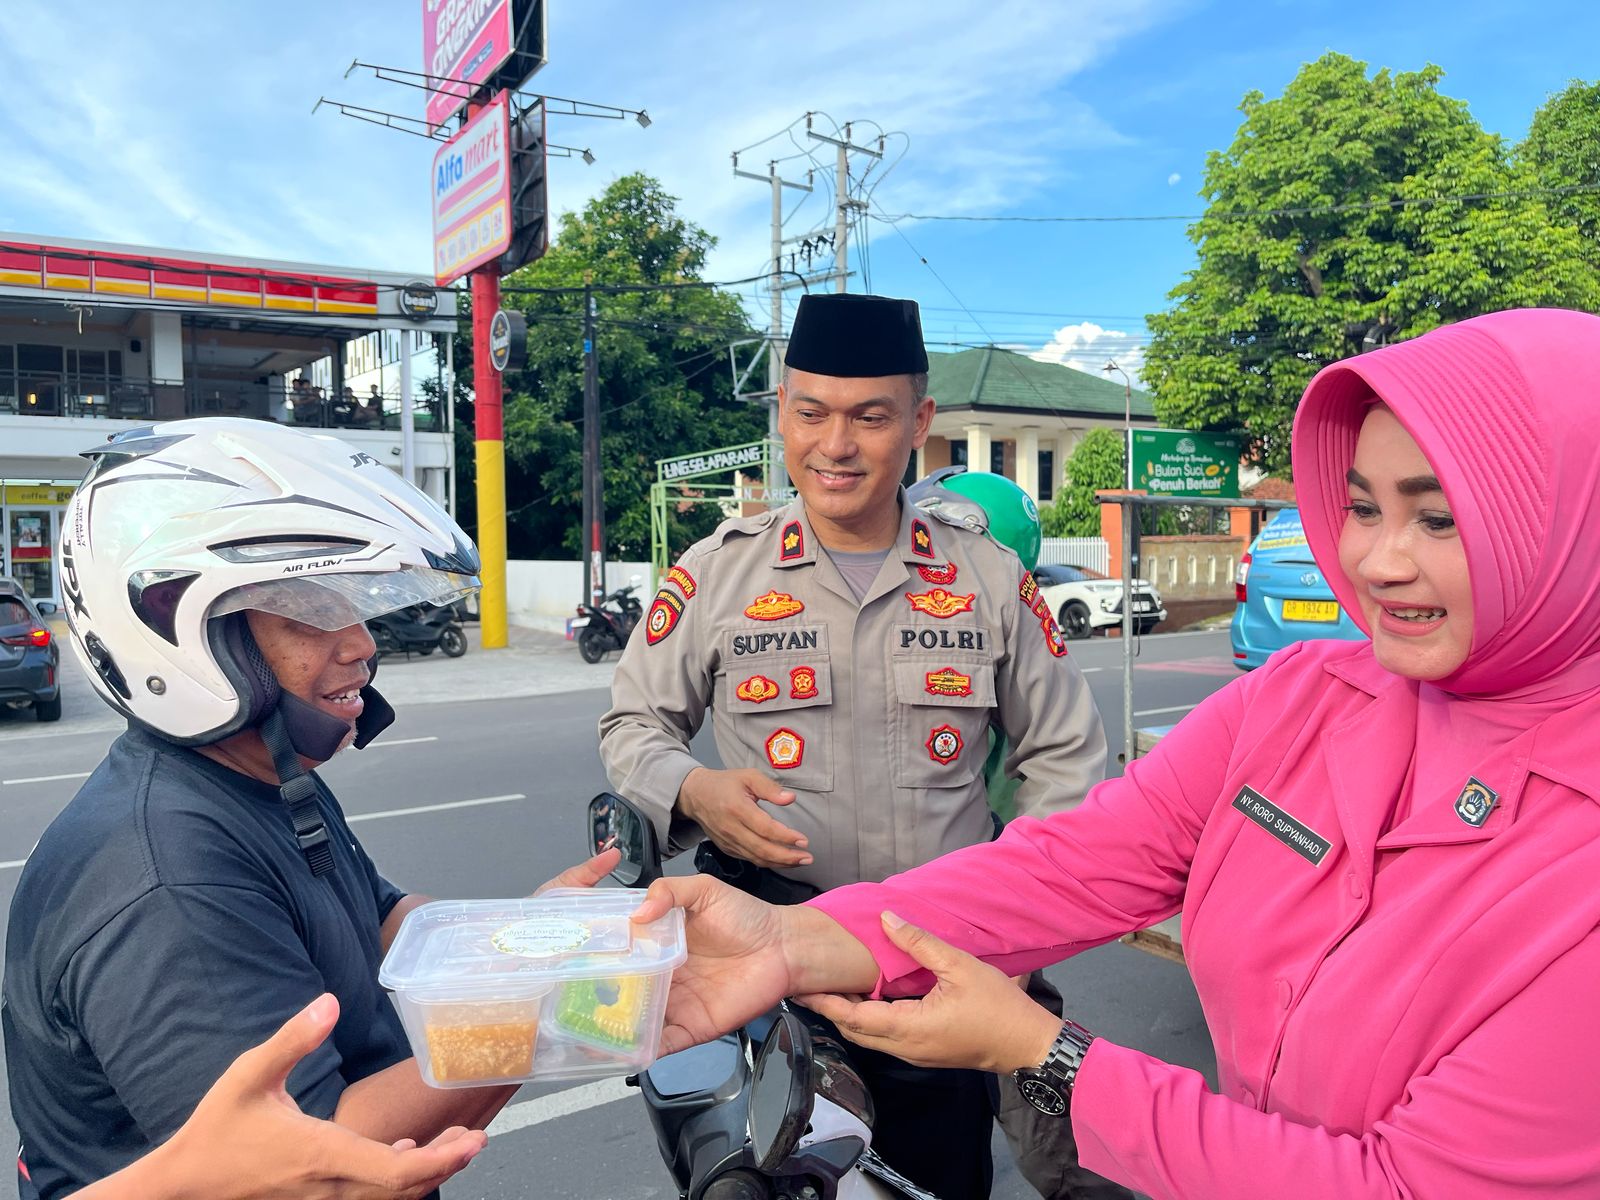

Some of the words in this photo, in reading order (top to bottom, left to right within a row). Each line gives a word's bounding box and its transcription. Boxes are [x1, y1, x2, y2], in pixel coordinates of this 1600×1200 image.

[1155, 464, 1182, 477] Bulan
[1149, 478, 1185, 491] Penuh
[1186, 477, 1221, 491] Berkah
[283, 564, 303, 573] AIR
[733, 631, 817, 656] SUPYAN
[900, 629, 984, 650] POLRI
[1240, 794, 1254, 809] NY.
[1251, 802, 1275, 823] RORO
[1274, 818, 1322, 857] SUPYANHADI
